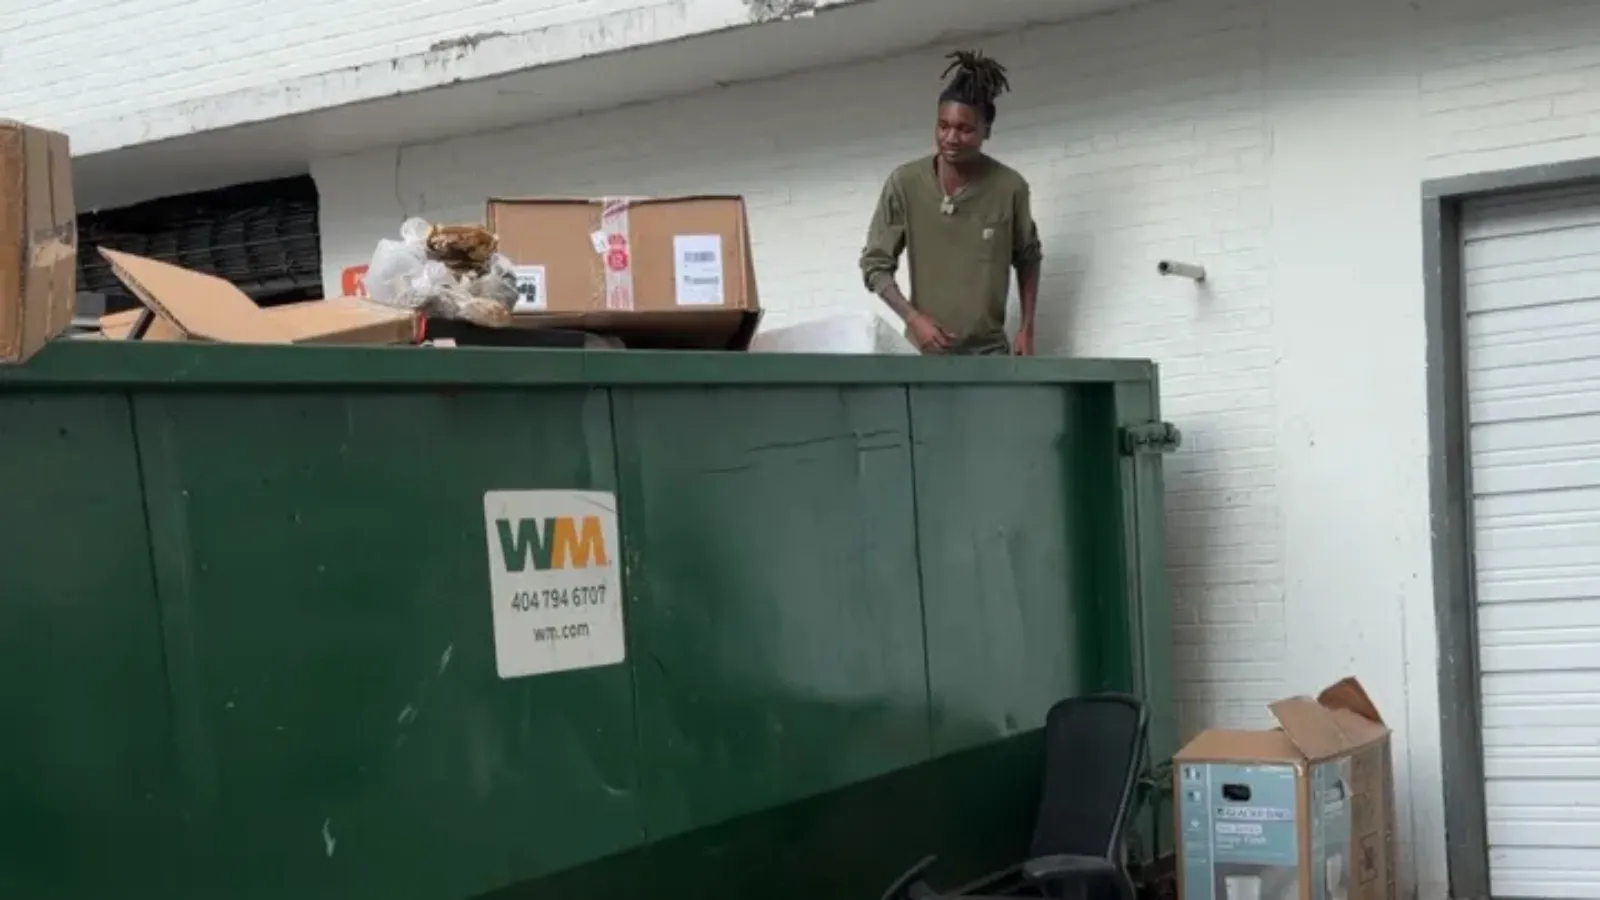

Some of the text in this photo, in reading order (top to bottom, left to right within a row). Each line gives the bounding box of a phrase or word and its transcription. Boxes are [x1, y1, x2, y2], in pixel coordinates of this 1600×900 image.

[496, 515, 608, 572] WM
[511, 585, 606, 612] 404 794 6707
[533, 622, 590, 642] wm.com
